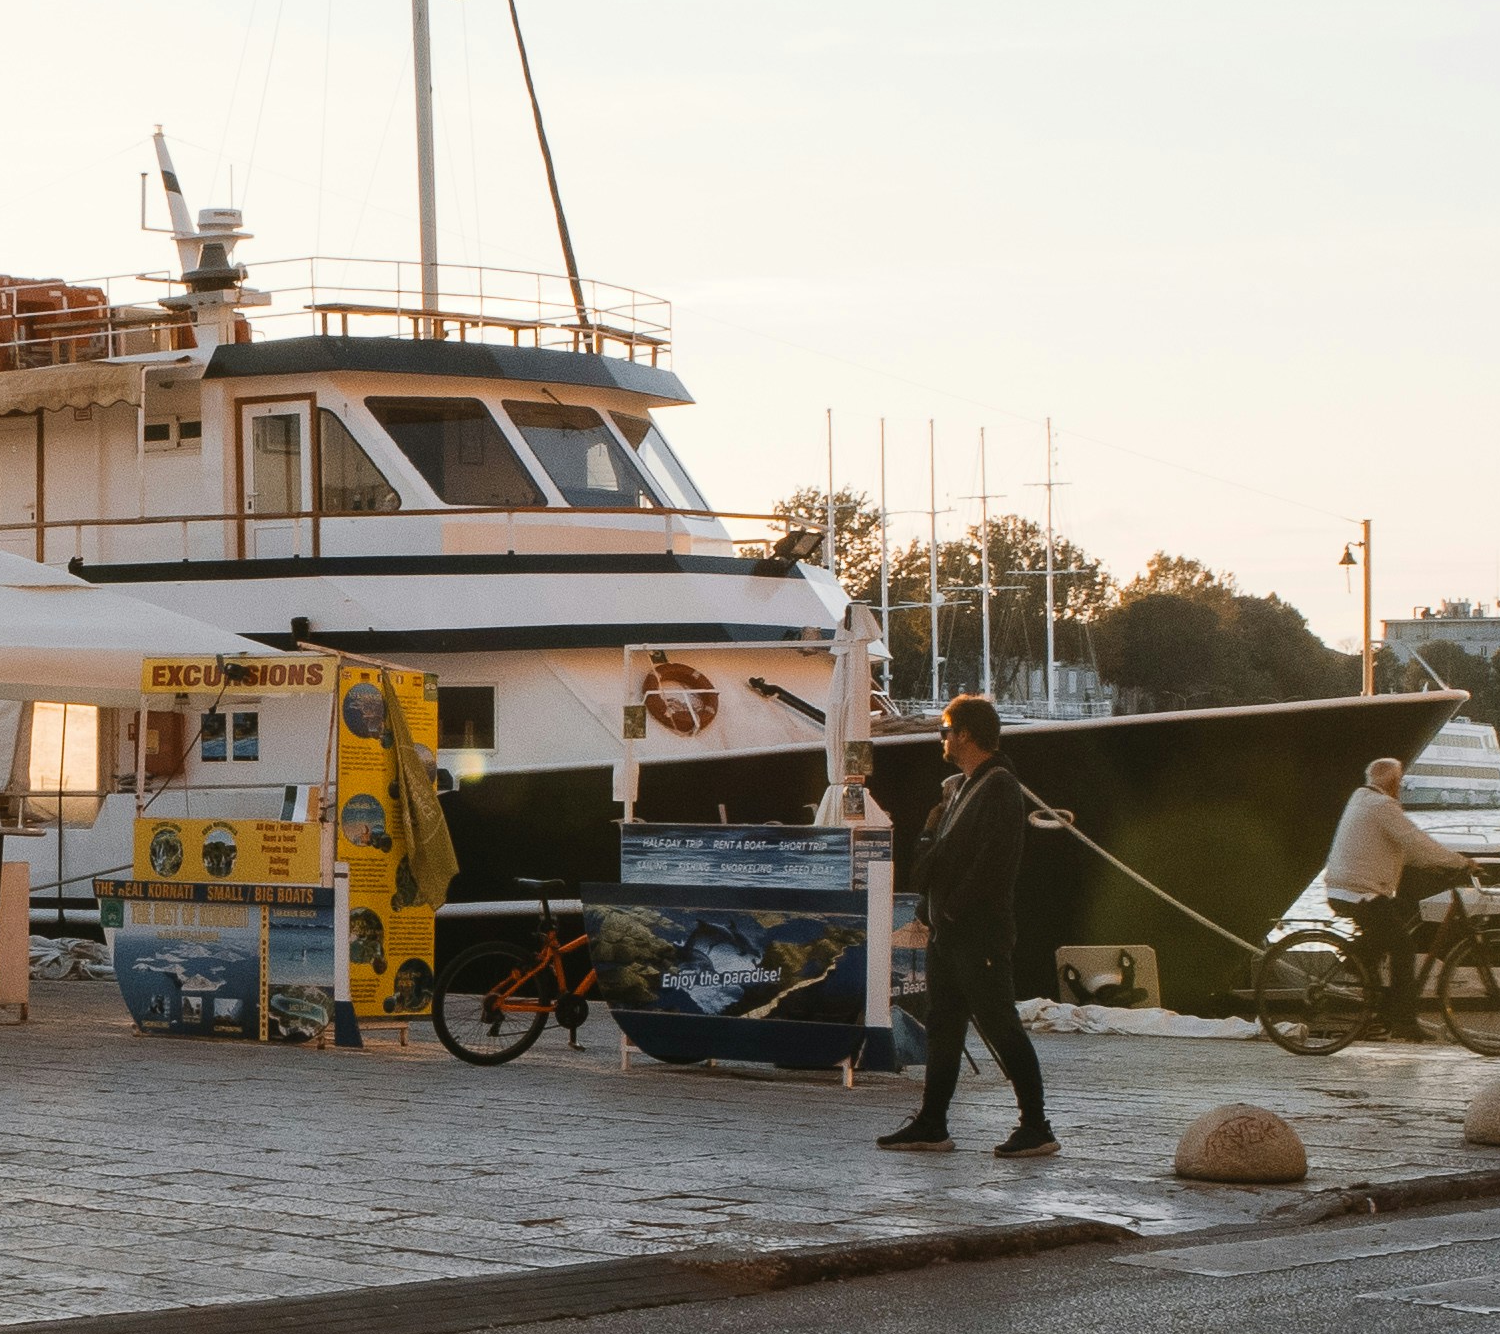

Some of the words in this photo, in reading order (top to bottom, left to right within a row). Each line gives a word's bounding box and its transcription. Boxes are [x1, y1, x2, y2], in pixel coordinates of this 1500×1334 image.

[685, 839, 703, 849] TRIP
[713, 840, 735, 850] RENT
[744, 841, 767, 850] BOAT
[778, 841, 807, 851] SHORT
[809, 842, 828, 851] TRIP
[720, 863, 772, 874] SNORKELING
[783, 864, 809, 875] SPEED
[95, 881, 113, 896] THE
[148, 883, 194, 900] KORNATI
[207, 885, 243, 902] SMALL
[255, 886, 273, 902] BIG
[277, 887, 314, 904] BOATS
[662, 973, 696, 991] Enjoy
[700, 971, 721, 987] the
[723, 968, 782, 989] paradise!
